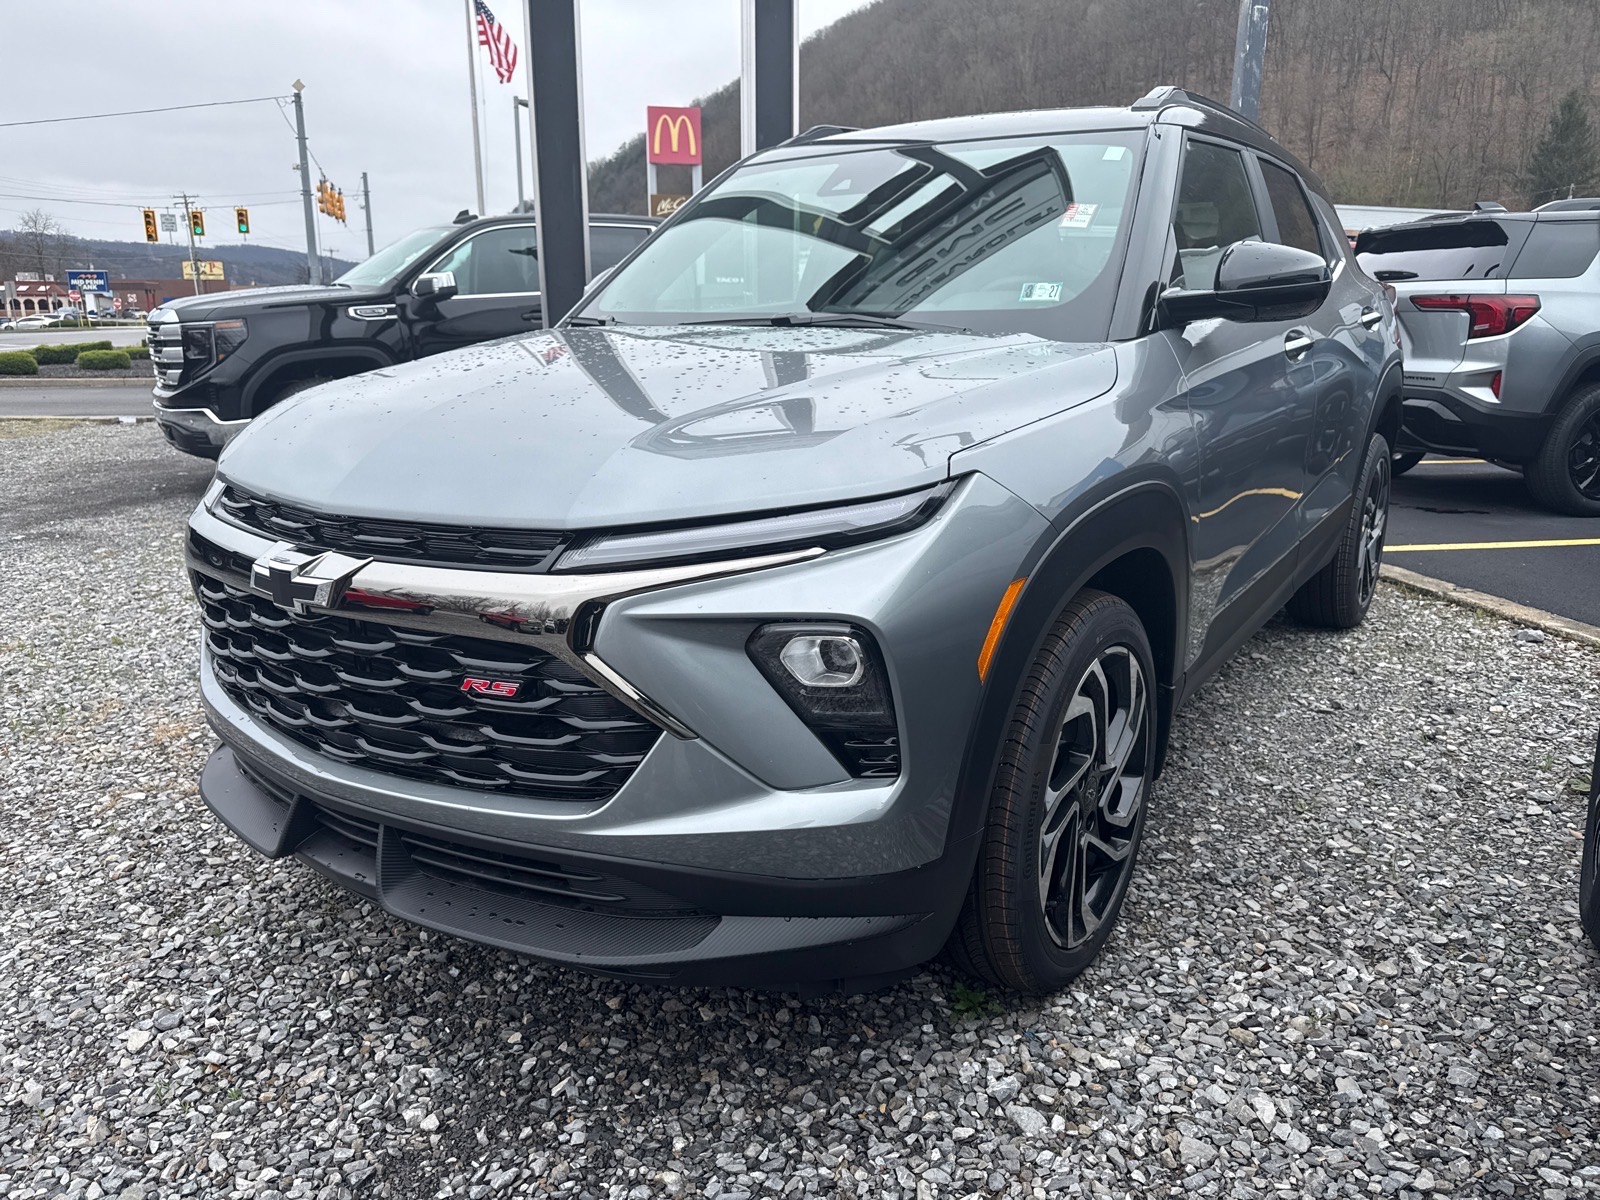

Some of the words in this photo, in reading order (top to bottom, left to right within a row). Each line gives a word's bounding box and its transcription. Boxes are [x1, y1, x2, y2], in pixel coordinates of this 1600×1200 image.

[656, 196, 687, 214] McC
[1048, 284, 1060, 298] 27
[460, 677, 520, 697] RS
